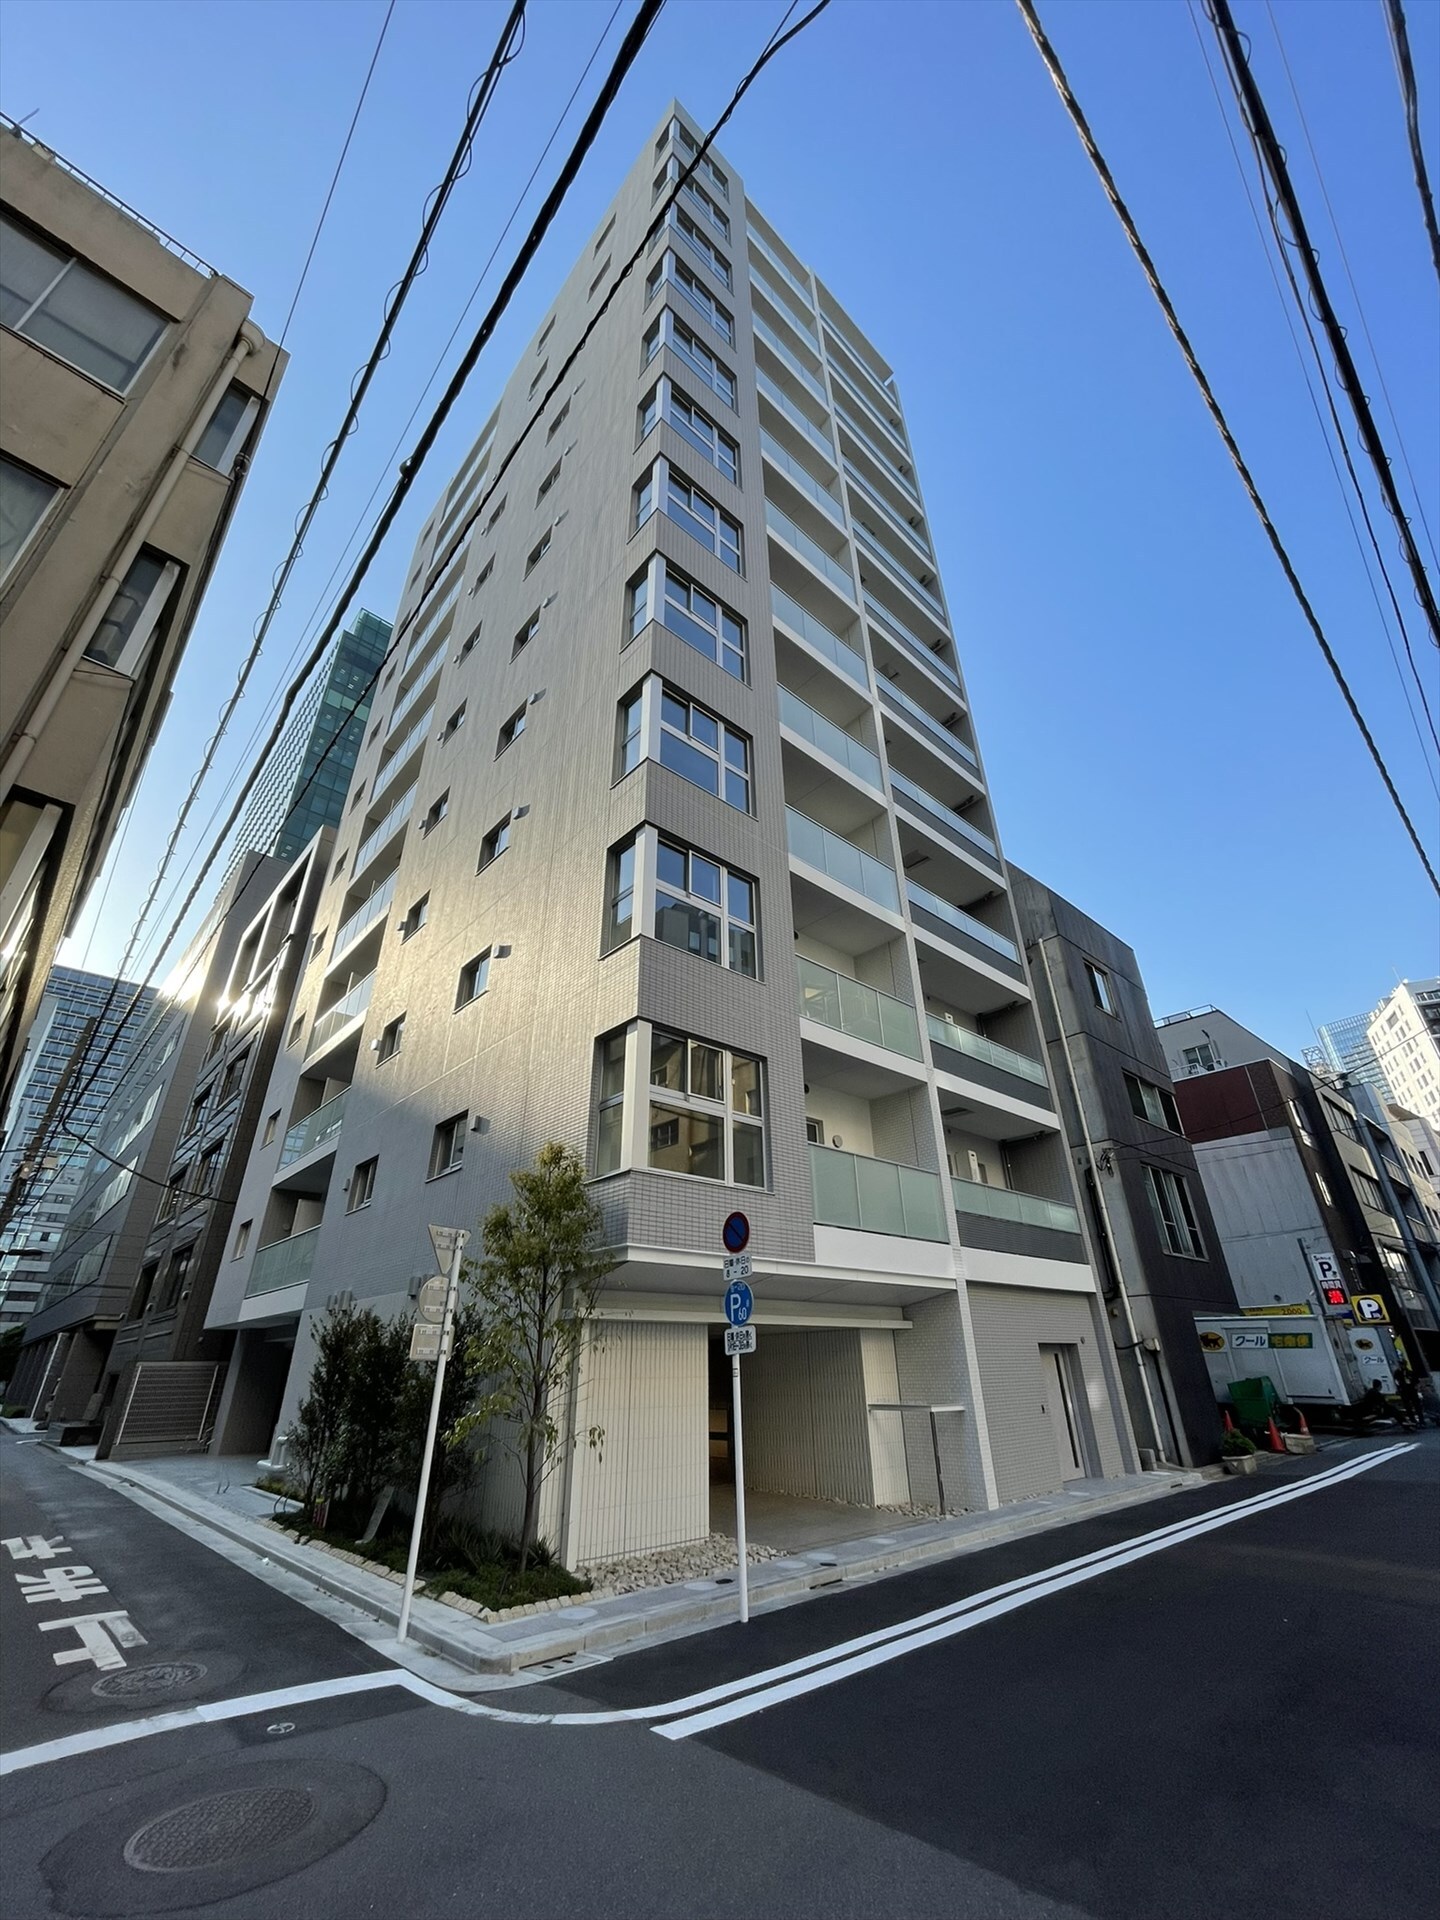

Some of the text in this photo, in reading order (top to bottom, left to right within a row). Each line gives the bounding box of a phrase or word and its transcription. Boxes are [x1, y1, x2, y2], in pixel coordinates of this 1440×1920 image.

[741, 1265, 749, 1275] 20
[1319, 1261, 1332, 1278] P
[730, 1293, 741, 1322] P
[738, 1307, 747, 1321] 60
[1359, 1299, 1379, 1318] P
[1235, 1335, 1266, 1347] クール
[1364, 1356, 1385, 1364] クール
[1, 1535, 148, 1671] 止まれ
